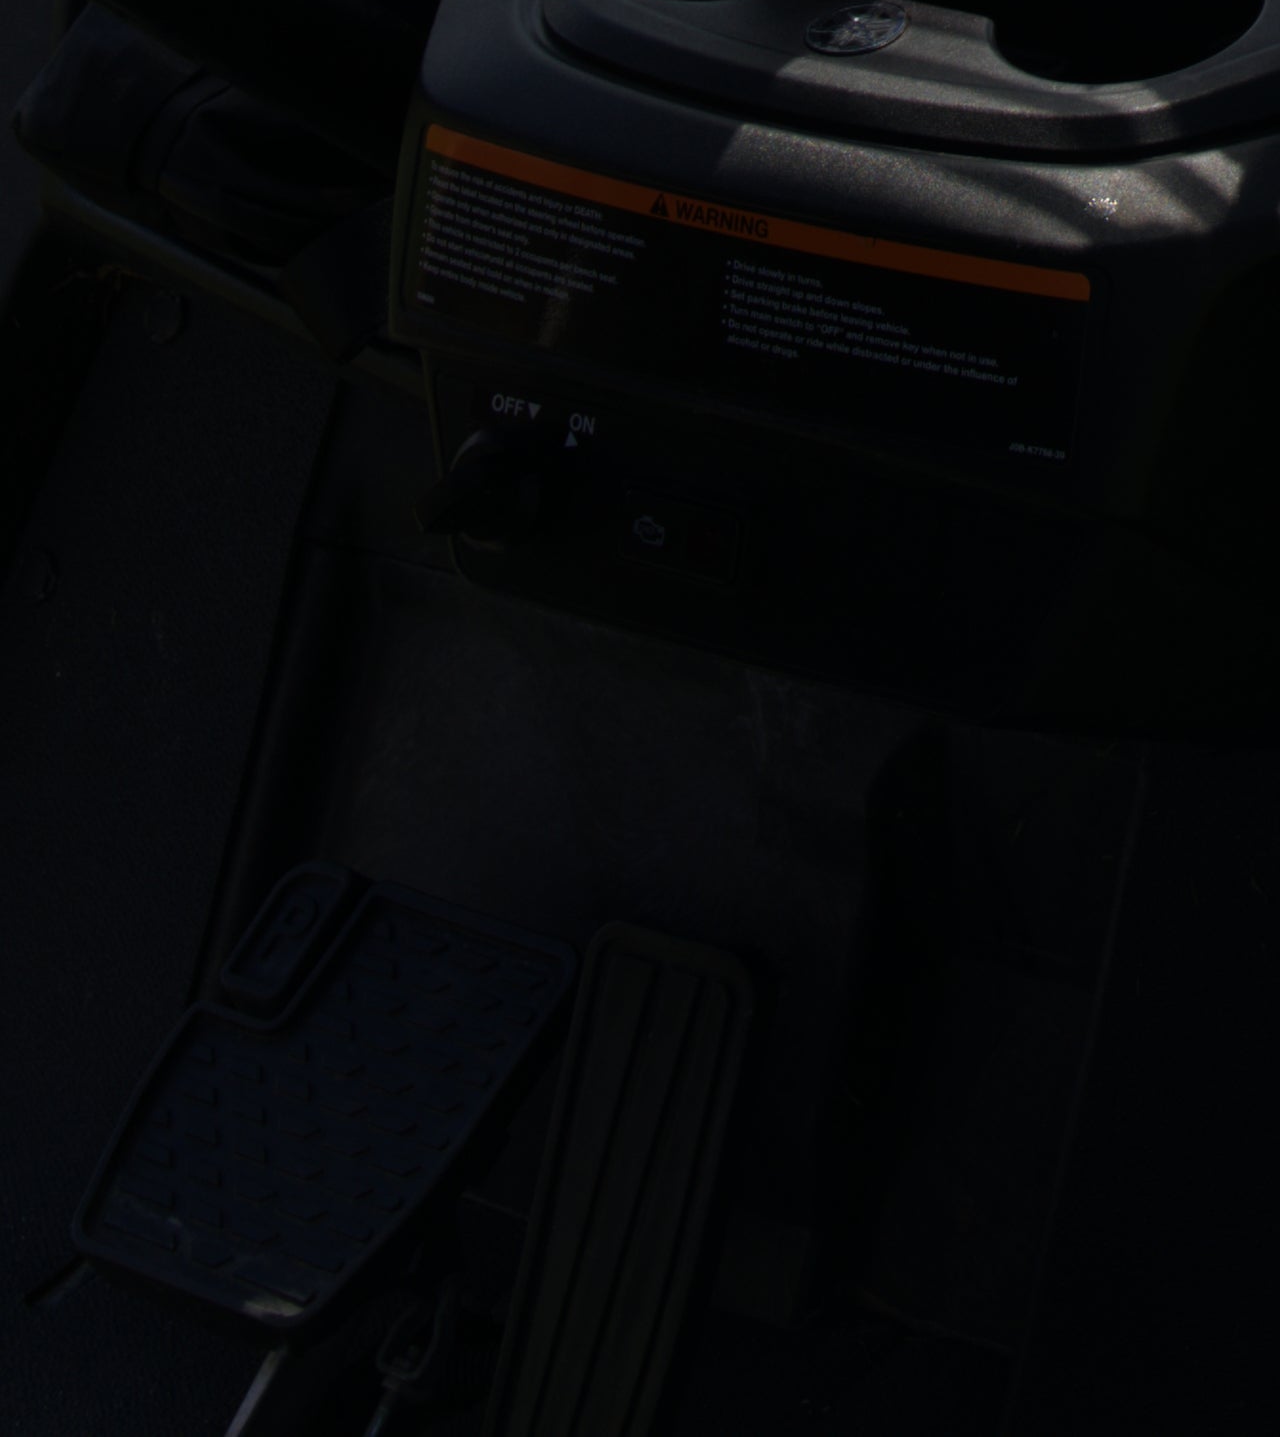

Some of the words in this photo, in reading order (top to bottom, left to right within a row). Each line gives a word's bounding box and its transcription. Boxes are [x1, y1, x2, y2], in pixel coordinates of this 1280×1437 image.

[675, 199, 769, 238] WARNING
[805, 292, 823, 304] and
[902, 340, 920, 354] key
[921, 342, 947, 357] when
[943, 362, 959, 376] the
[960, 367, 1005, 385] influence
[490, 392, 525, 417] OFF
[568, 411, 596, 436] ON
